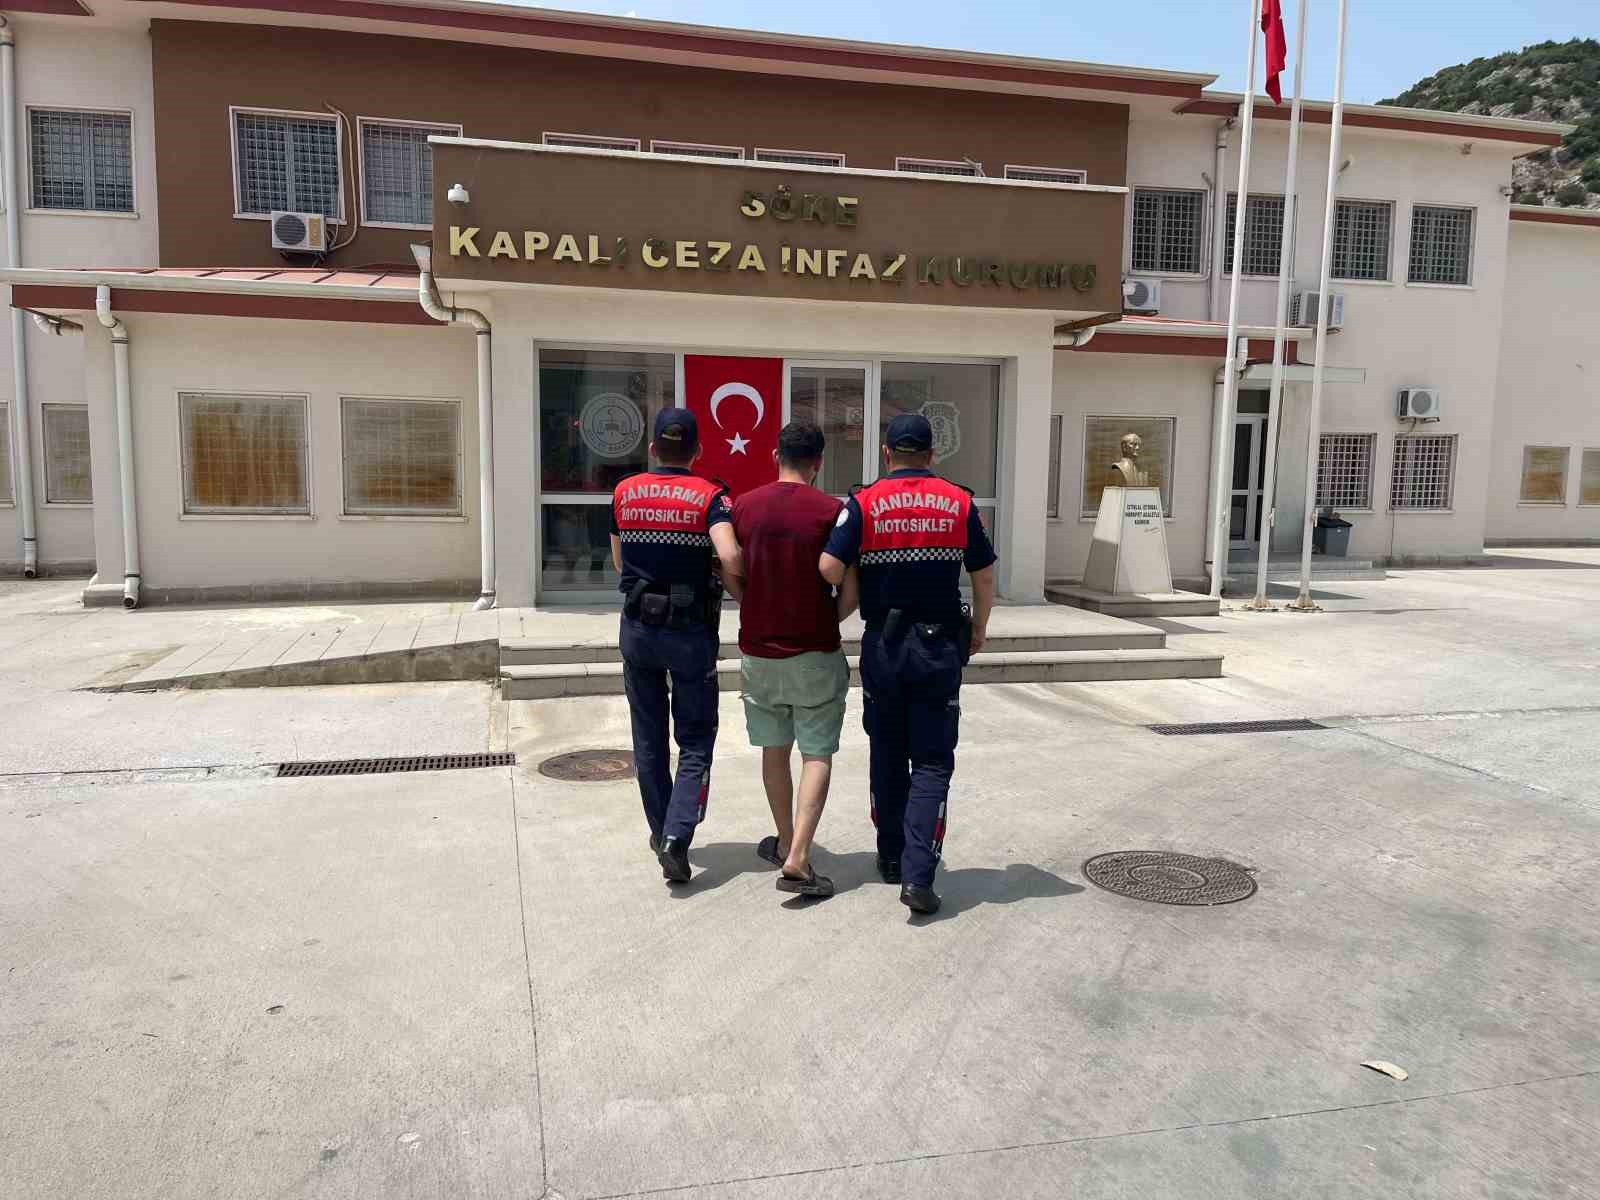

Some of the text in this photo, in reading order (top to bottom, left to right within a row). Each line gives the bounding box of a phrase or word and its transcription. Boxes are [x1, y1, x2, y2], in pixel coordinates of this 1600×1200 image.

[641, 238, 766, 272] CEZA
[621, 483, 705, 507] JANDARMA
[870, 492, 960, 517] JANDARMA
